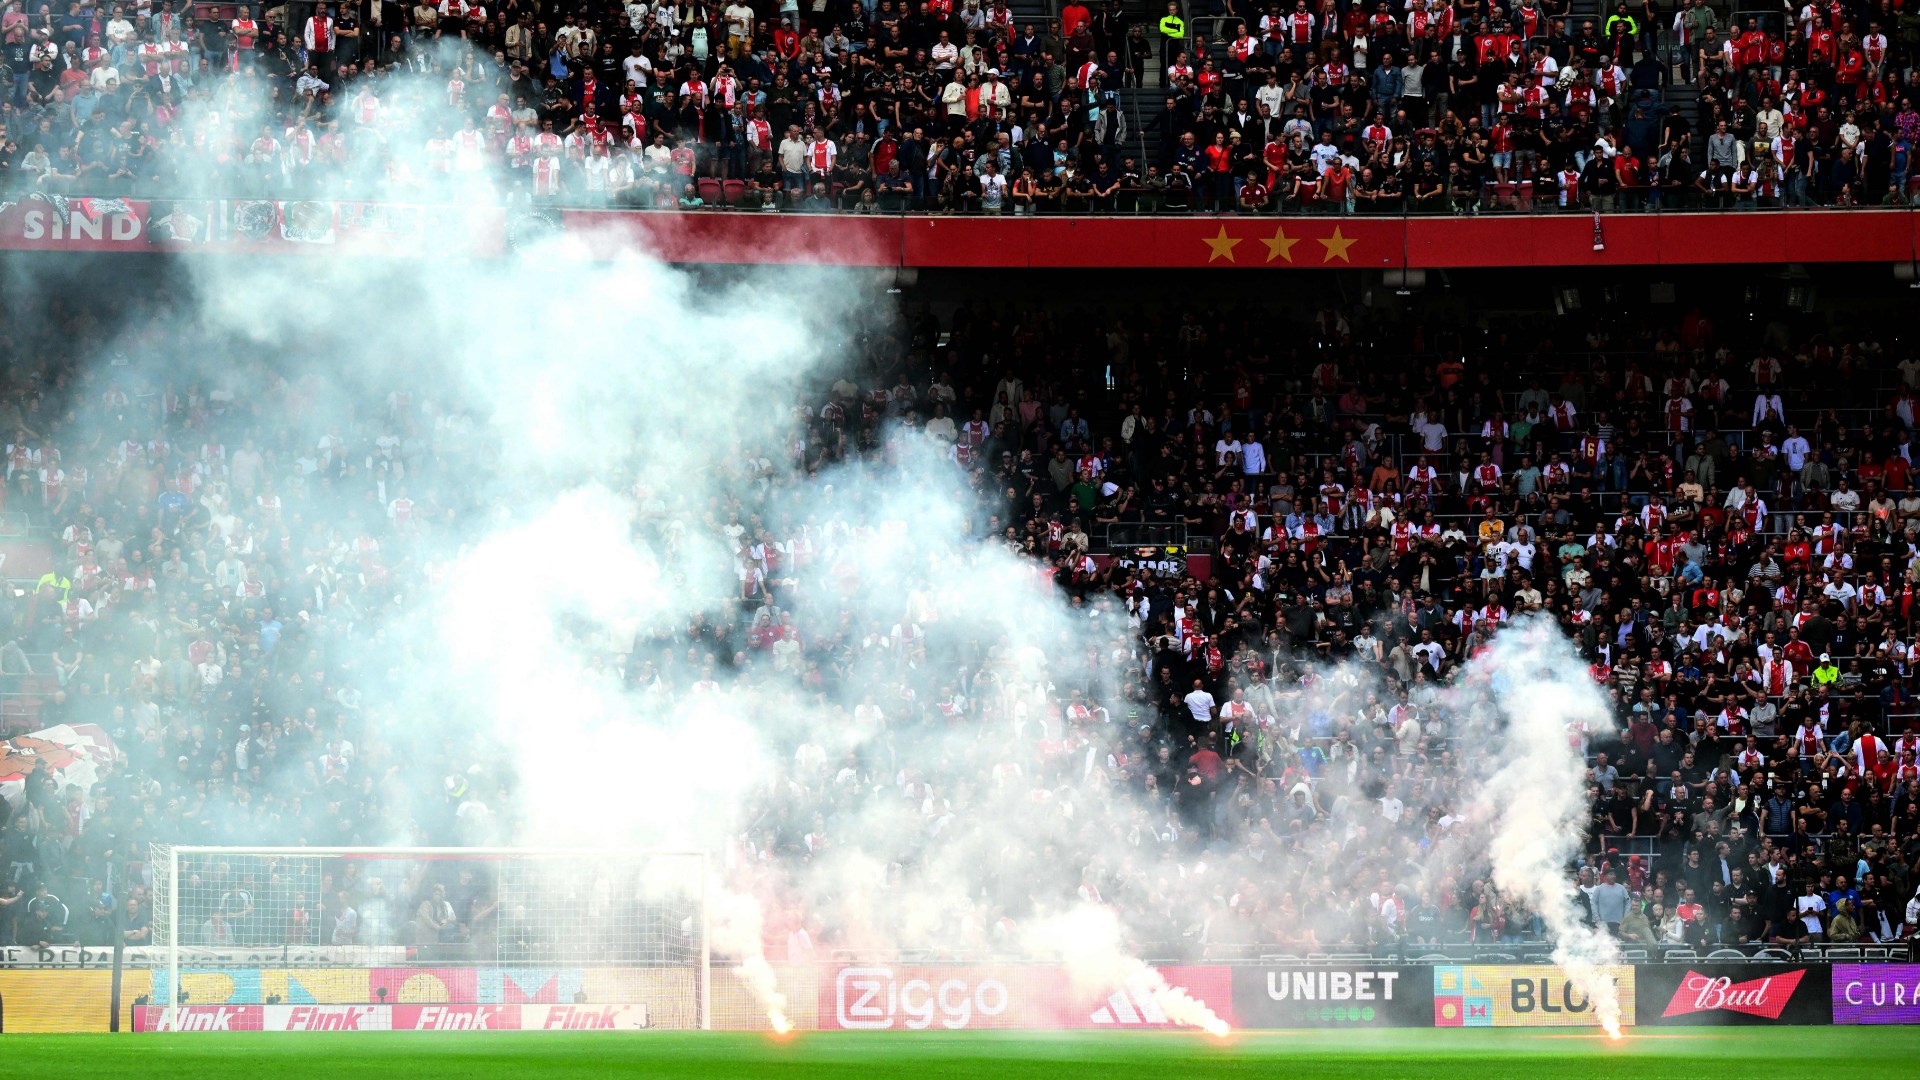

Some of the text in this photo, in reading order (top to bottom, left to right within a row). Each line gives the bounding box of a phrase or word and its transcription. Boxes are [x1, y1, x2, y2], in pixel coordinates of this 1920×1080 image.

[1587, 442, 1595, 458] 6
[1052, 526, 1062, 541] 31
[1267, 971, 1399, 1001] UNIBET
[1687, 976, 1772, 1009] Bud
[286, 1006, 375, 1031] Flink
[415, 1006, 503, 1031] Flink
[543, 1005, 631, 1030] Flink
